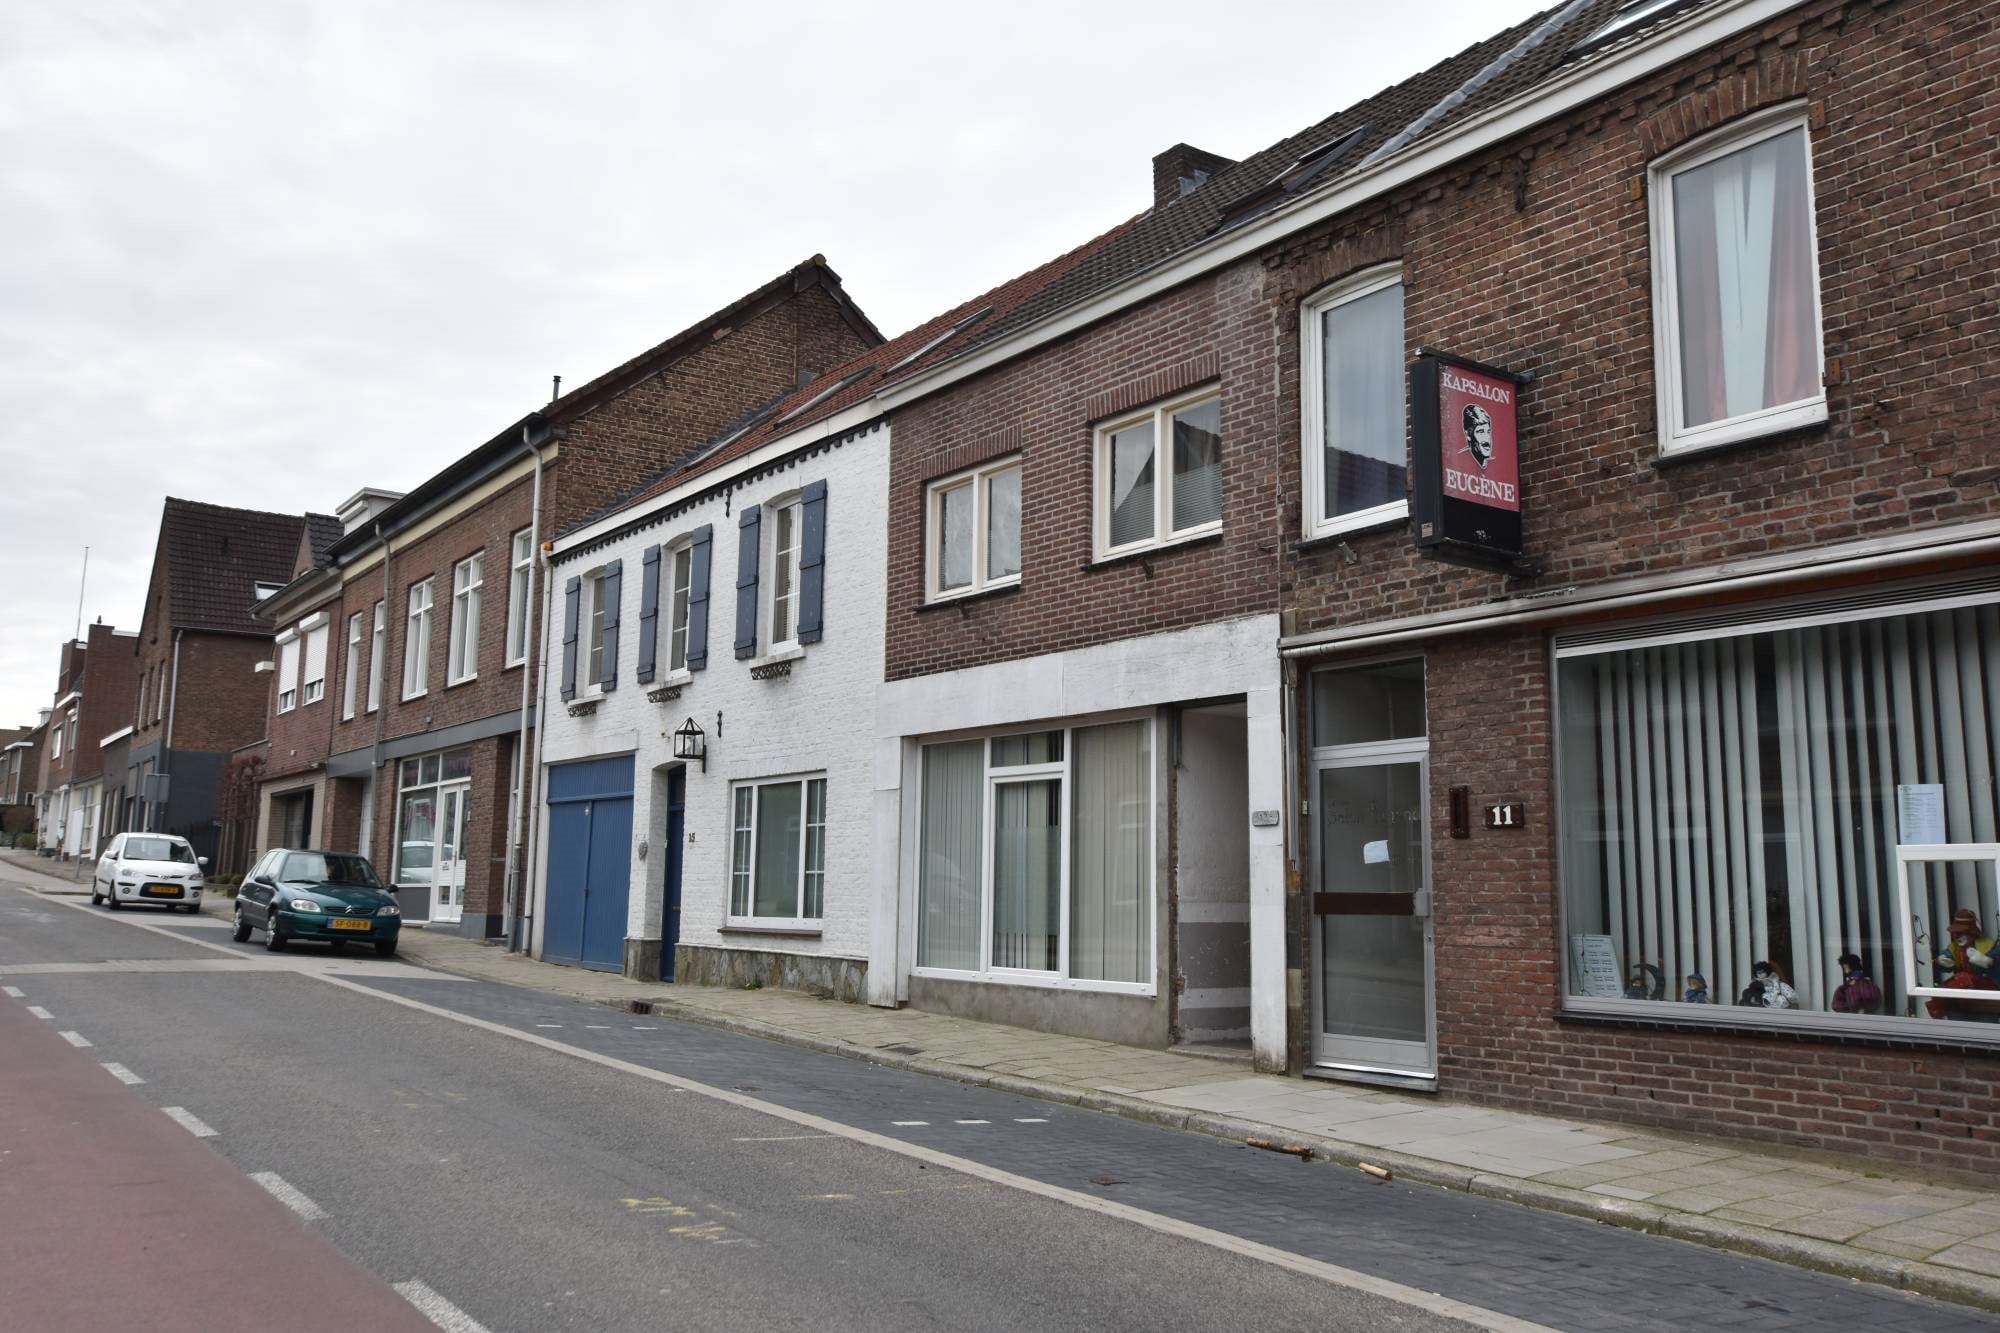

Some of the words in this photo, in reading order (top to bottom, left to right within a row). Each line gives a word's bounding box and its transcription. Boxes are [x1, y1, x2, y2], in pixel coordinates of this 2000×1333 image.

[1442, 373, 1510, 404] KAPSALON
[1446, 468, 1514, 502] EUGÈNE
[1492, 805, 1512, 825] 11
